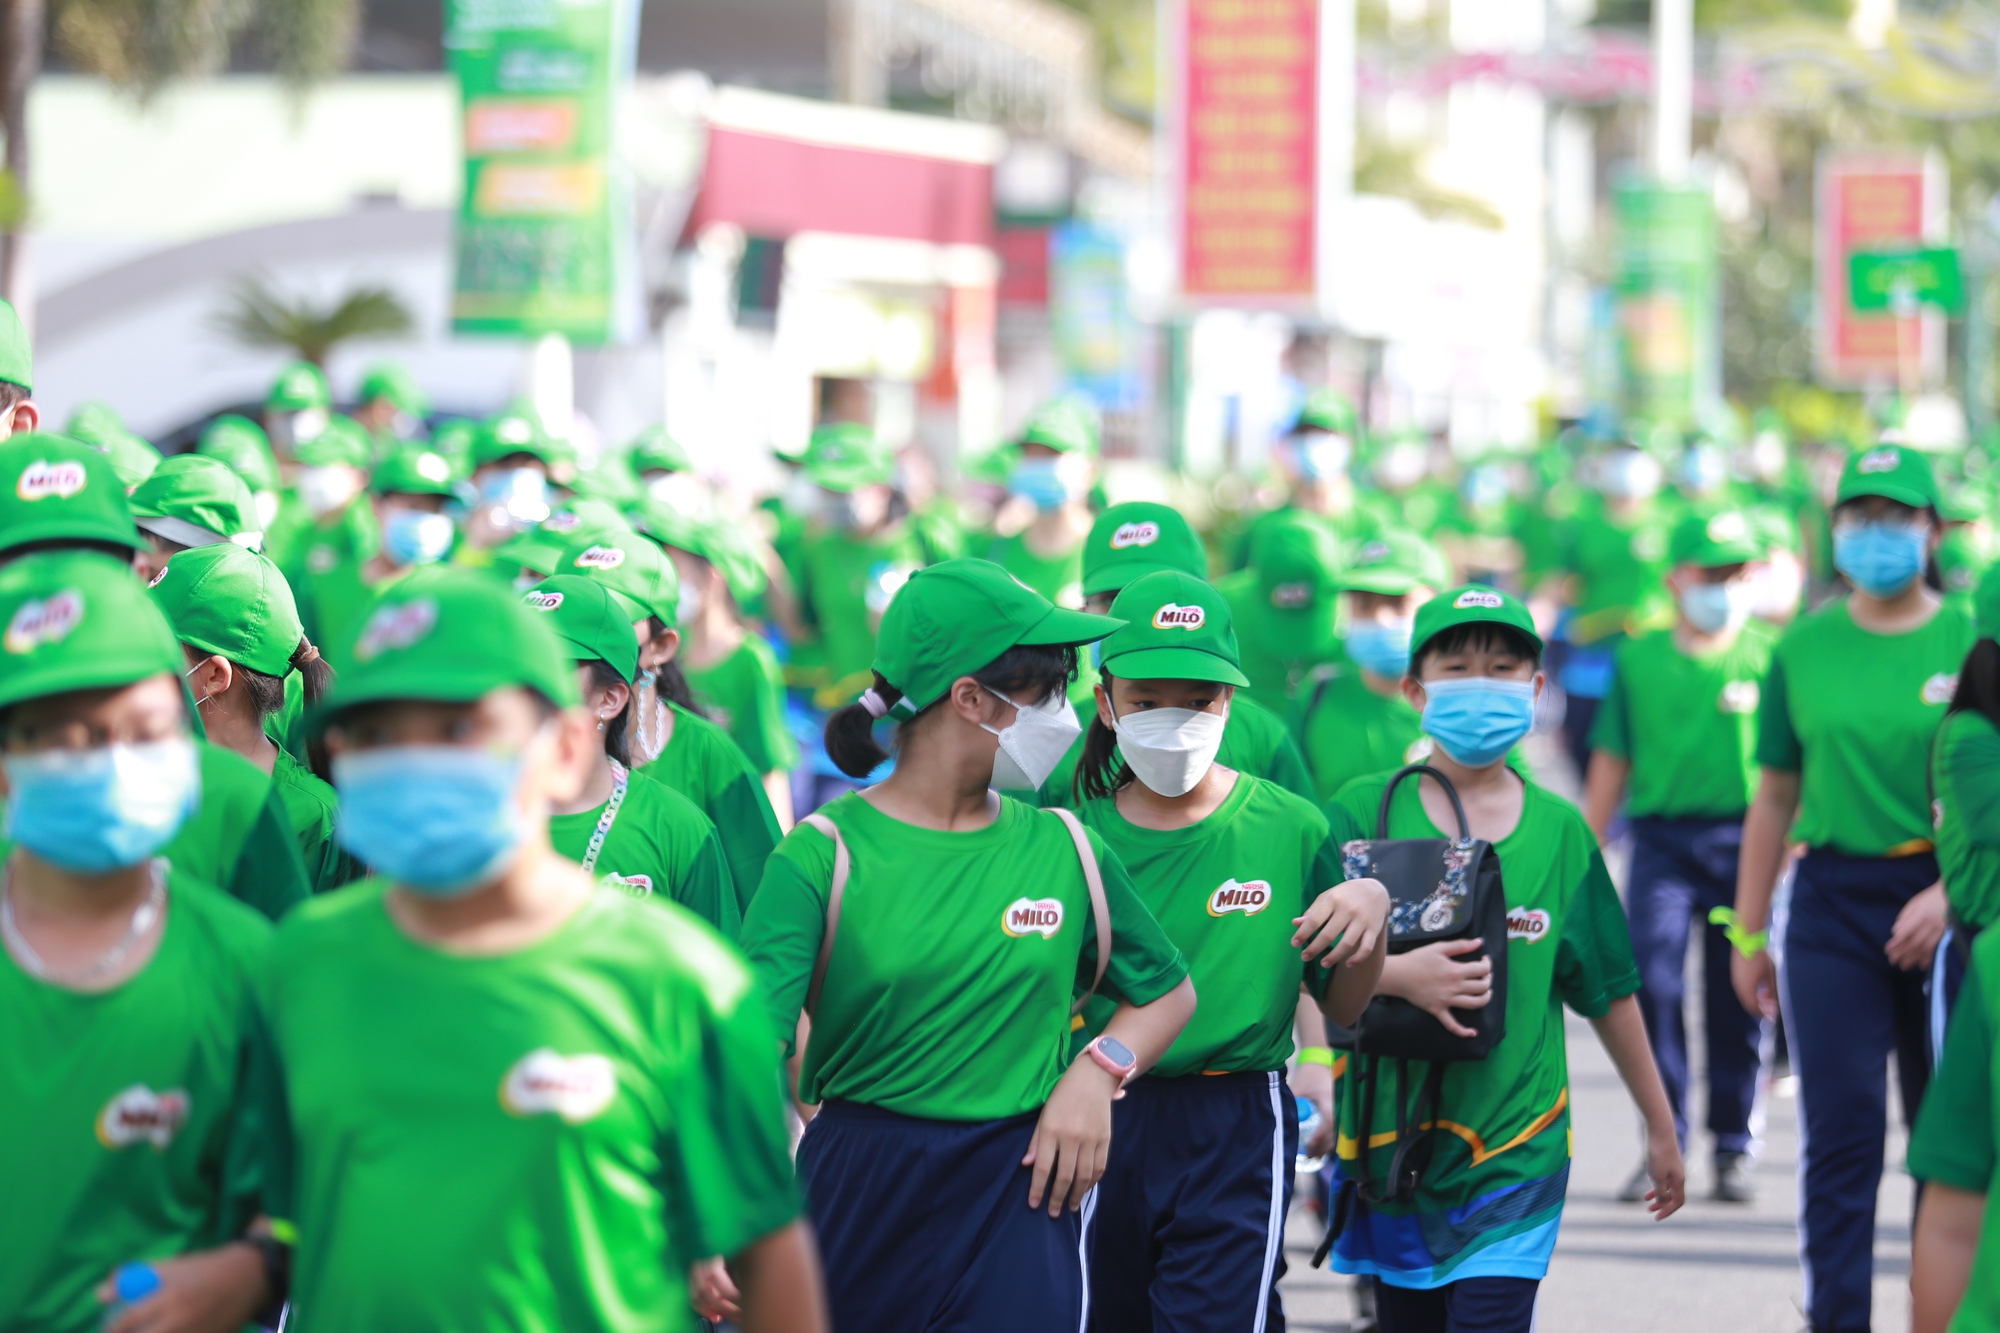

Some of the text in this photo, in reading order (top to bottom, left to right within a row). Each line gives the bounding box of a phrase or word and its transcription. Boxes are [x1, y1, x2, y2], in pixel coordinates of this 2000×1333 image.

[1160, 611, 1200, 623] MILO
[1216, 889, 1265, 907] MILO
[1011, 908, 1059, 926] MILO
